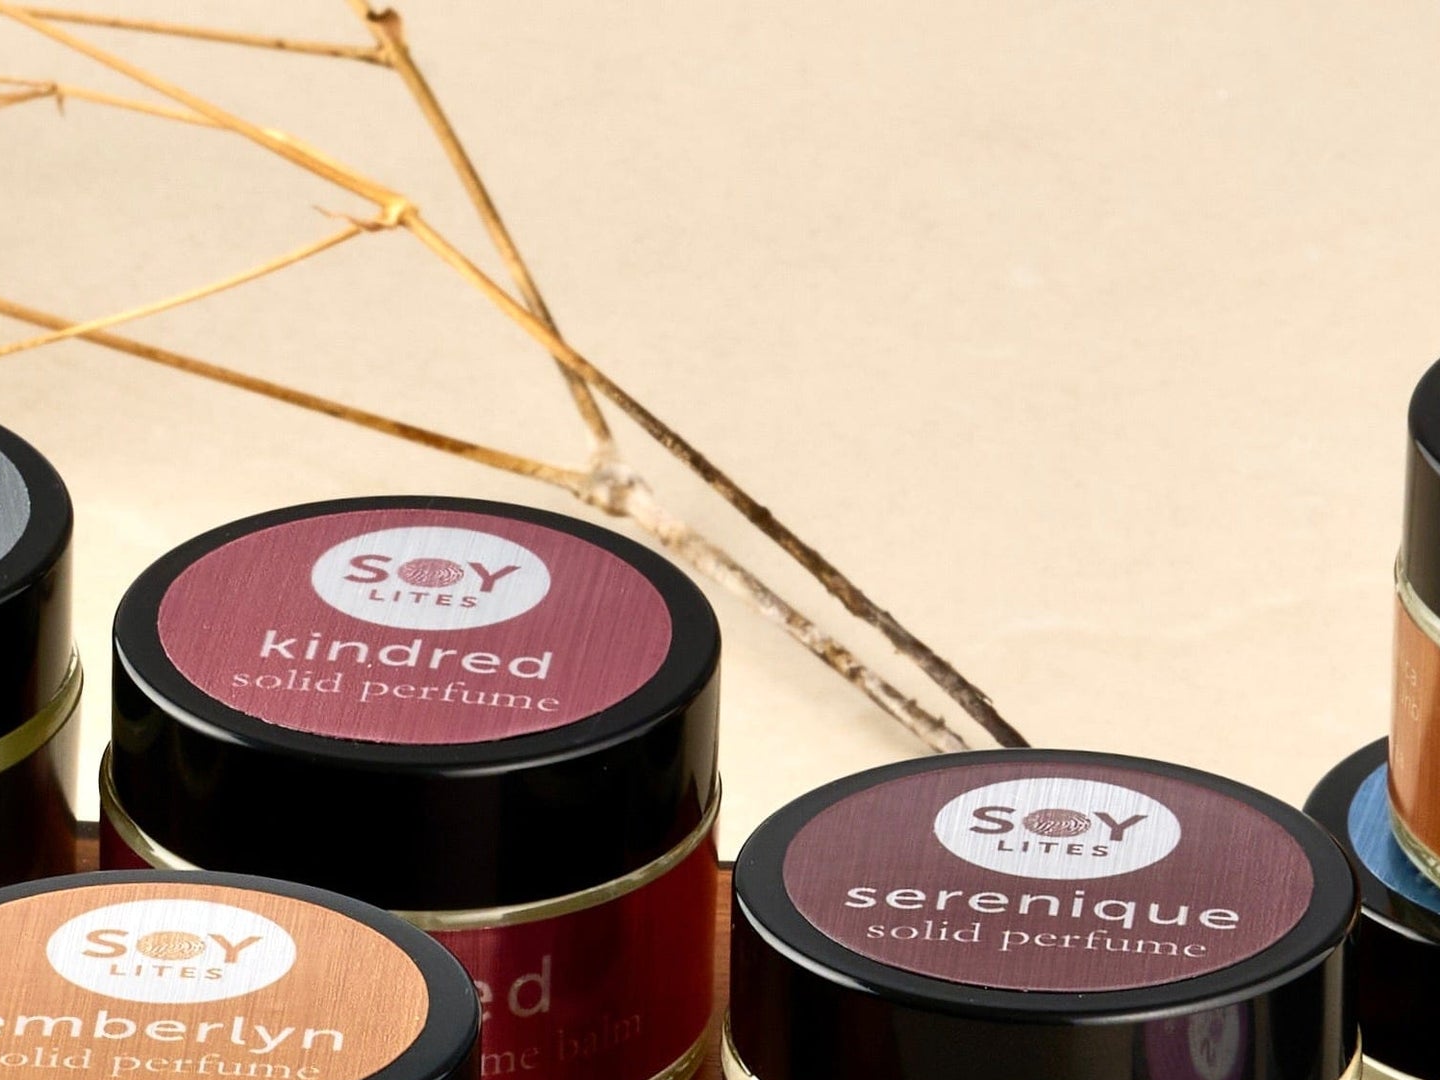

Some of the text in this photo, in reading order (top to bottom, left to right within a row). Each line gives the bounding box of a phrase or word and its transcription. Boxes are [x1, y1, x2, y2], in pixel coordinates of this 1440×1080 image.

[344, 554, 521, 593] SOY
[369, 589, 478, 608] LITES
[259, 630, 552, 679] kindred
[231, 668, 560, 712] solid perfume
[969, 805, 1148, 841] SOY
[997, 840, 1109, 857] LITES
[844, 886, 1240, 930] serenique
[81, 929, 262, 964] SOY
[866, 919, 1207, 959] solid perfume
[109, 964, 224, 980] LITES
[111, 1051, 321, 1080] perfume
